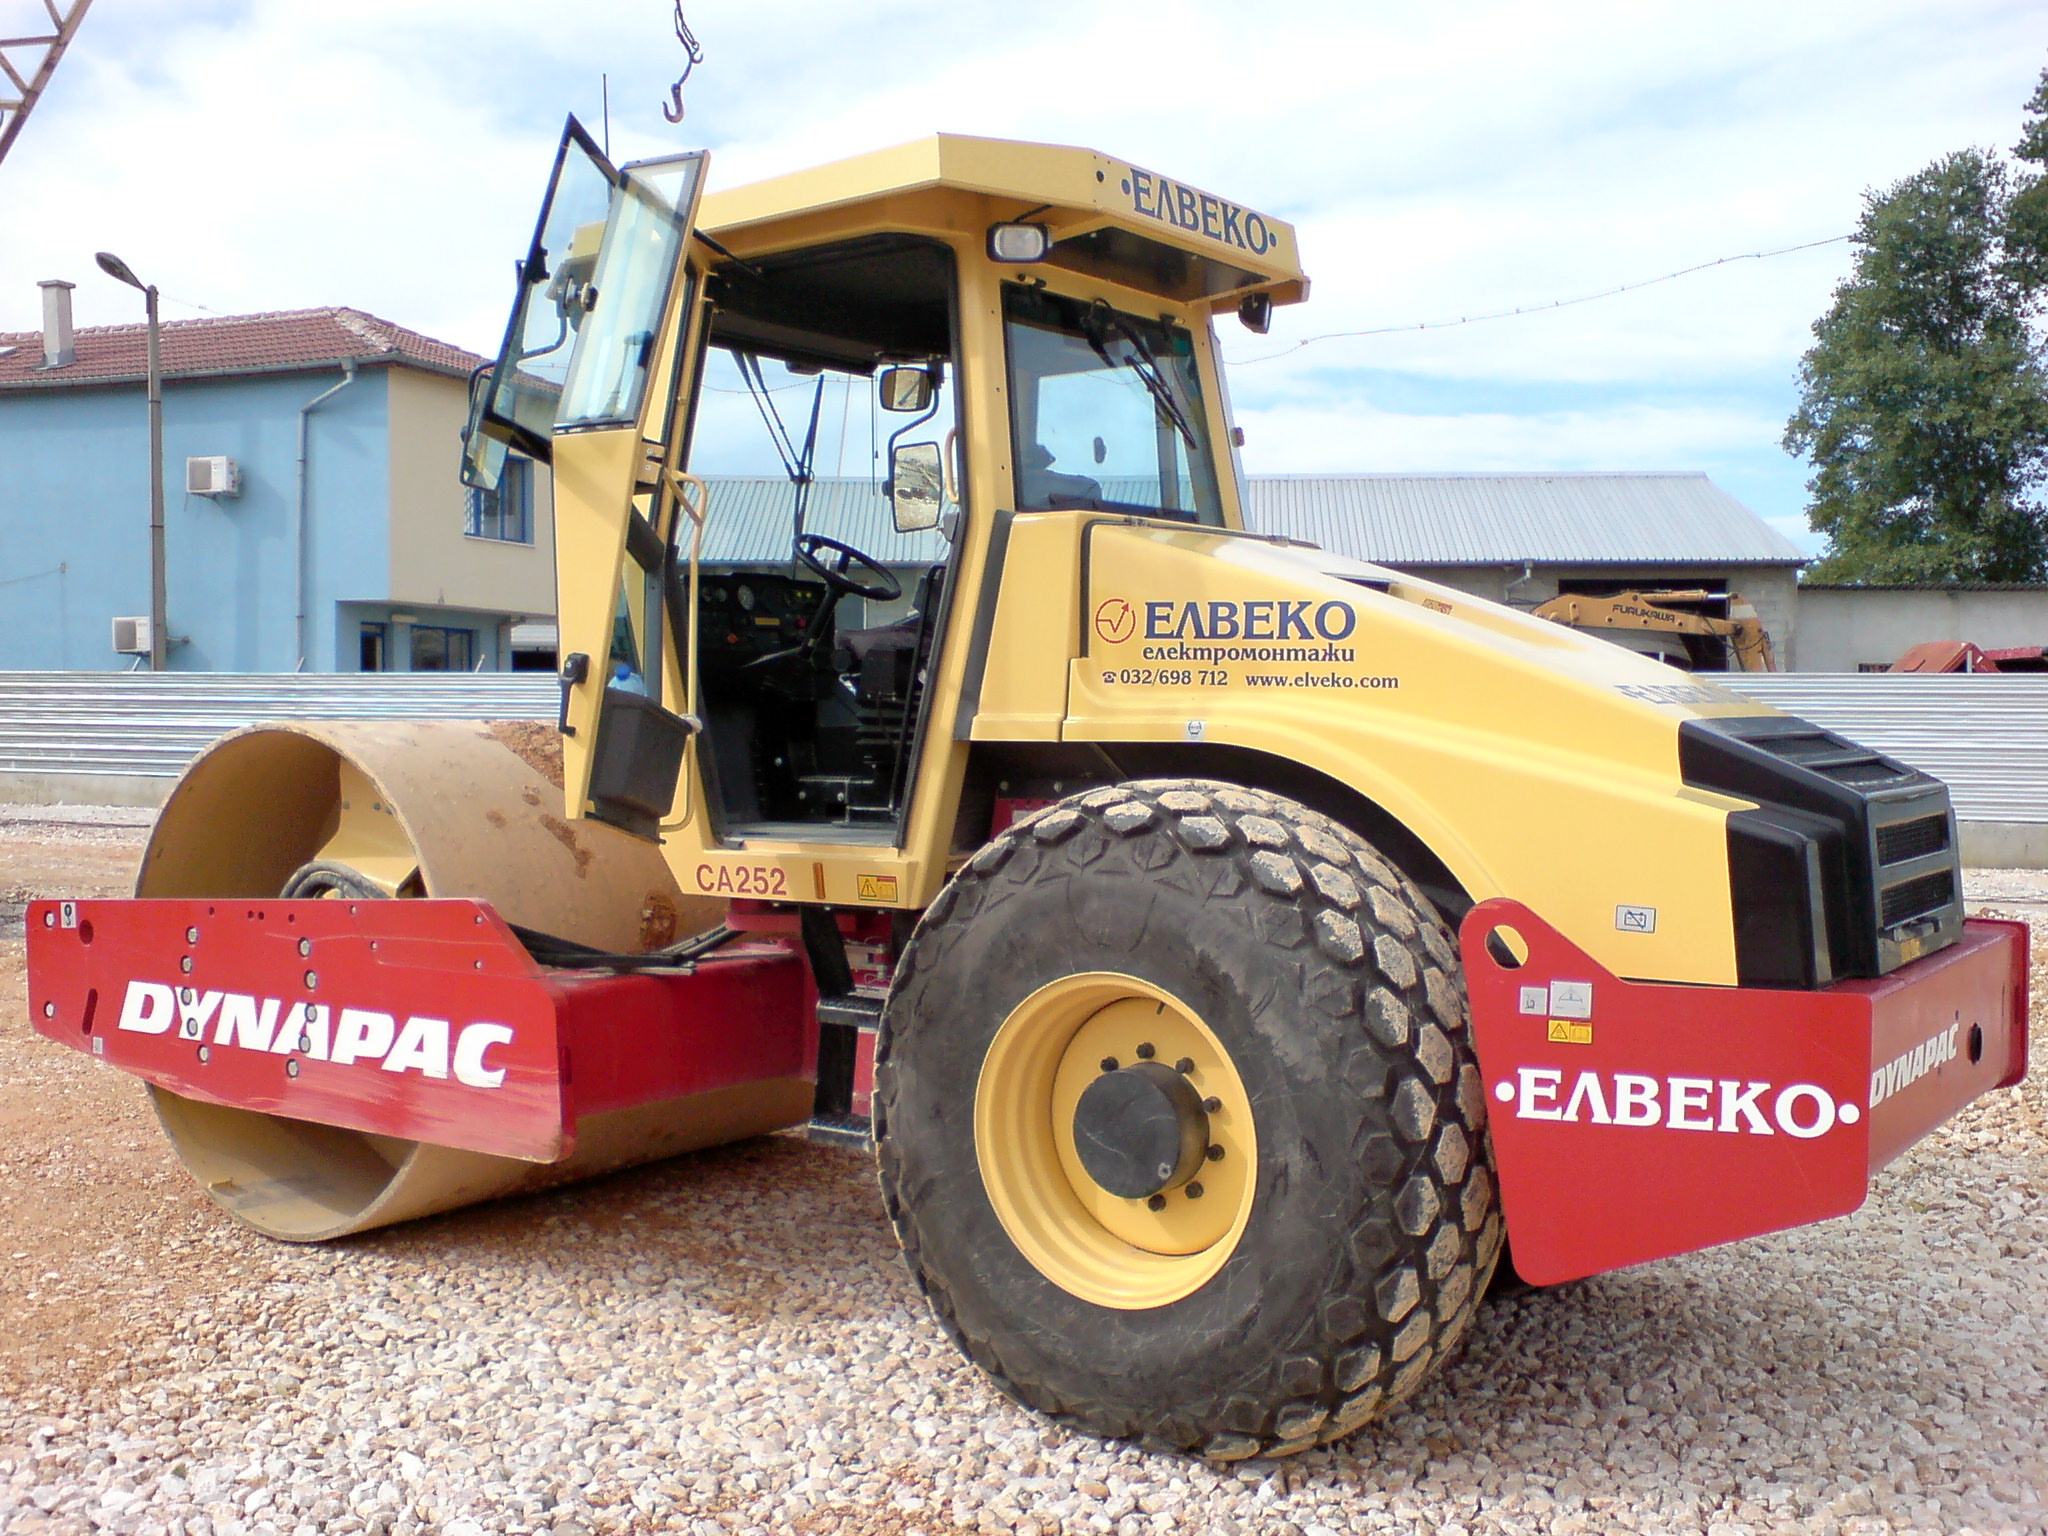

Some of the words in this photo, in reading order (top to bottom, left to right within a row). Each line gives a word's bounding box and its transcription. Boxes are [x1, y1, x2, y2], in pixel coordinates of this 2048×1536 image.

[1612, 604, 1676, 622] FURUKAWA
[1142, 642, 1355, 665] електромонтажи
[1120, 669, 1192, 687] 032/698
[1198, 670, 1228, 686] 712
[1245, 672, 1399, 689] www.elveko.com
[696, 864, 787, 896] CA252
[118, 980, 514, 1088] DYNAPAC
[1869, 1022, 1959, 1109] DYNAPAC
